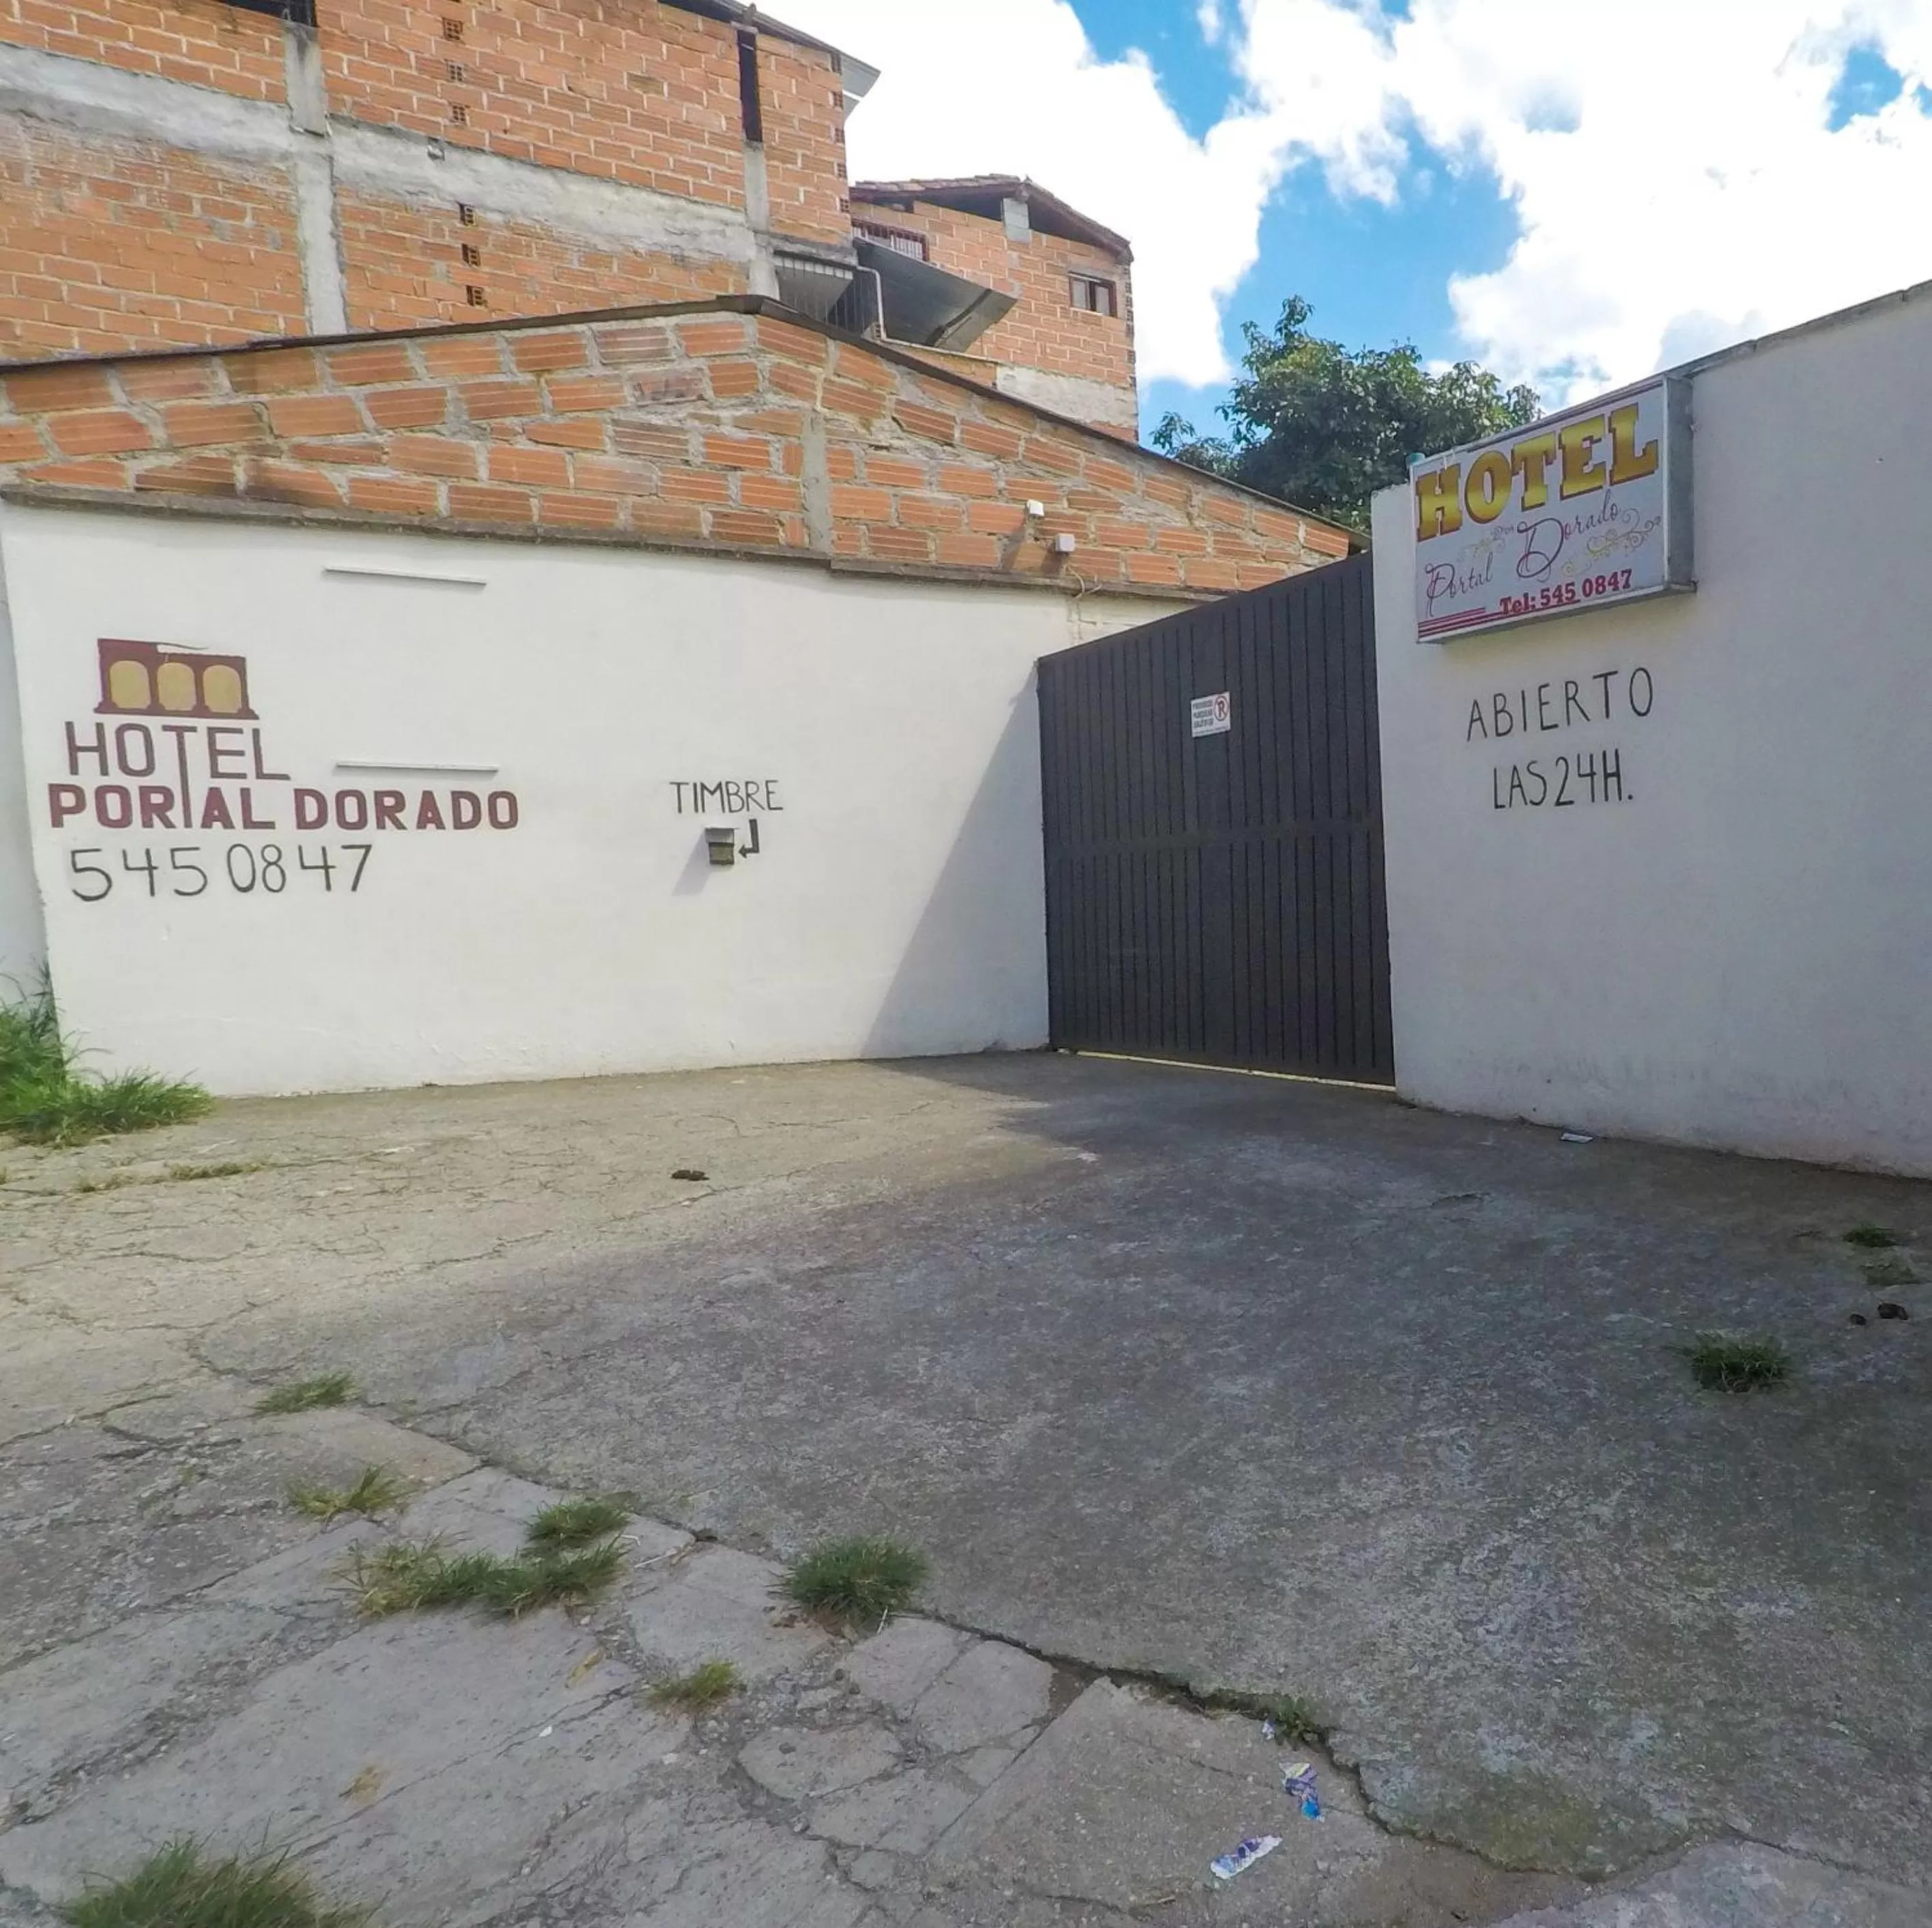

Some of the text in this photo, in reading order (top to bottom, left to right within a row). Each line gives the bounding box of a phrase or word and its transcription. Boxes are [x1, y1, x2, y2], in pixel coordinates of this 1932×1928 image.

[1416, 403, 1659, 542] HOTEL
[1426, 488, 1619, 617] Portal Dorado
[1540, 582, 1577, 606] 545
[1582, 568, 1632, 598] 0847
[1467, 667, 1653, 742] ABIERTO
[64, 721, 292, 781] HOTEL
[47, 783, 519, 831] PORTAL DORADO
[669, 780, 783, 813] TIMBRE
